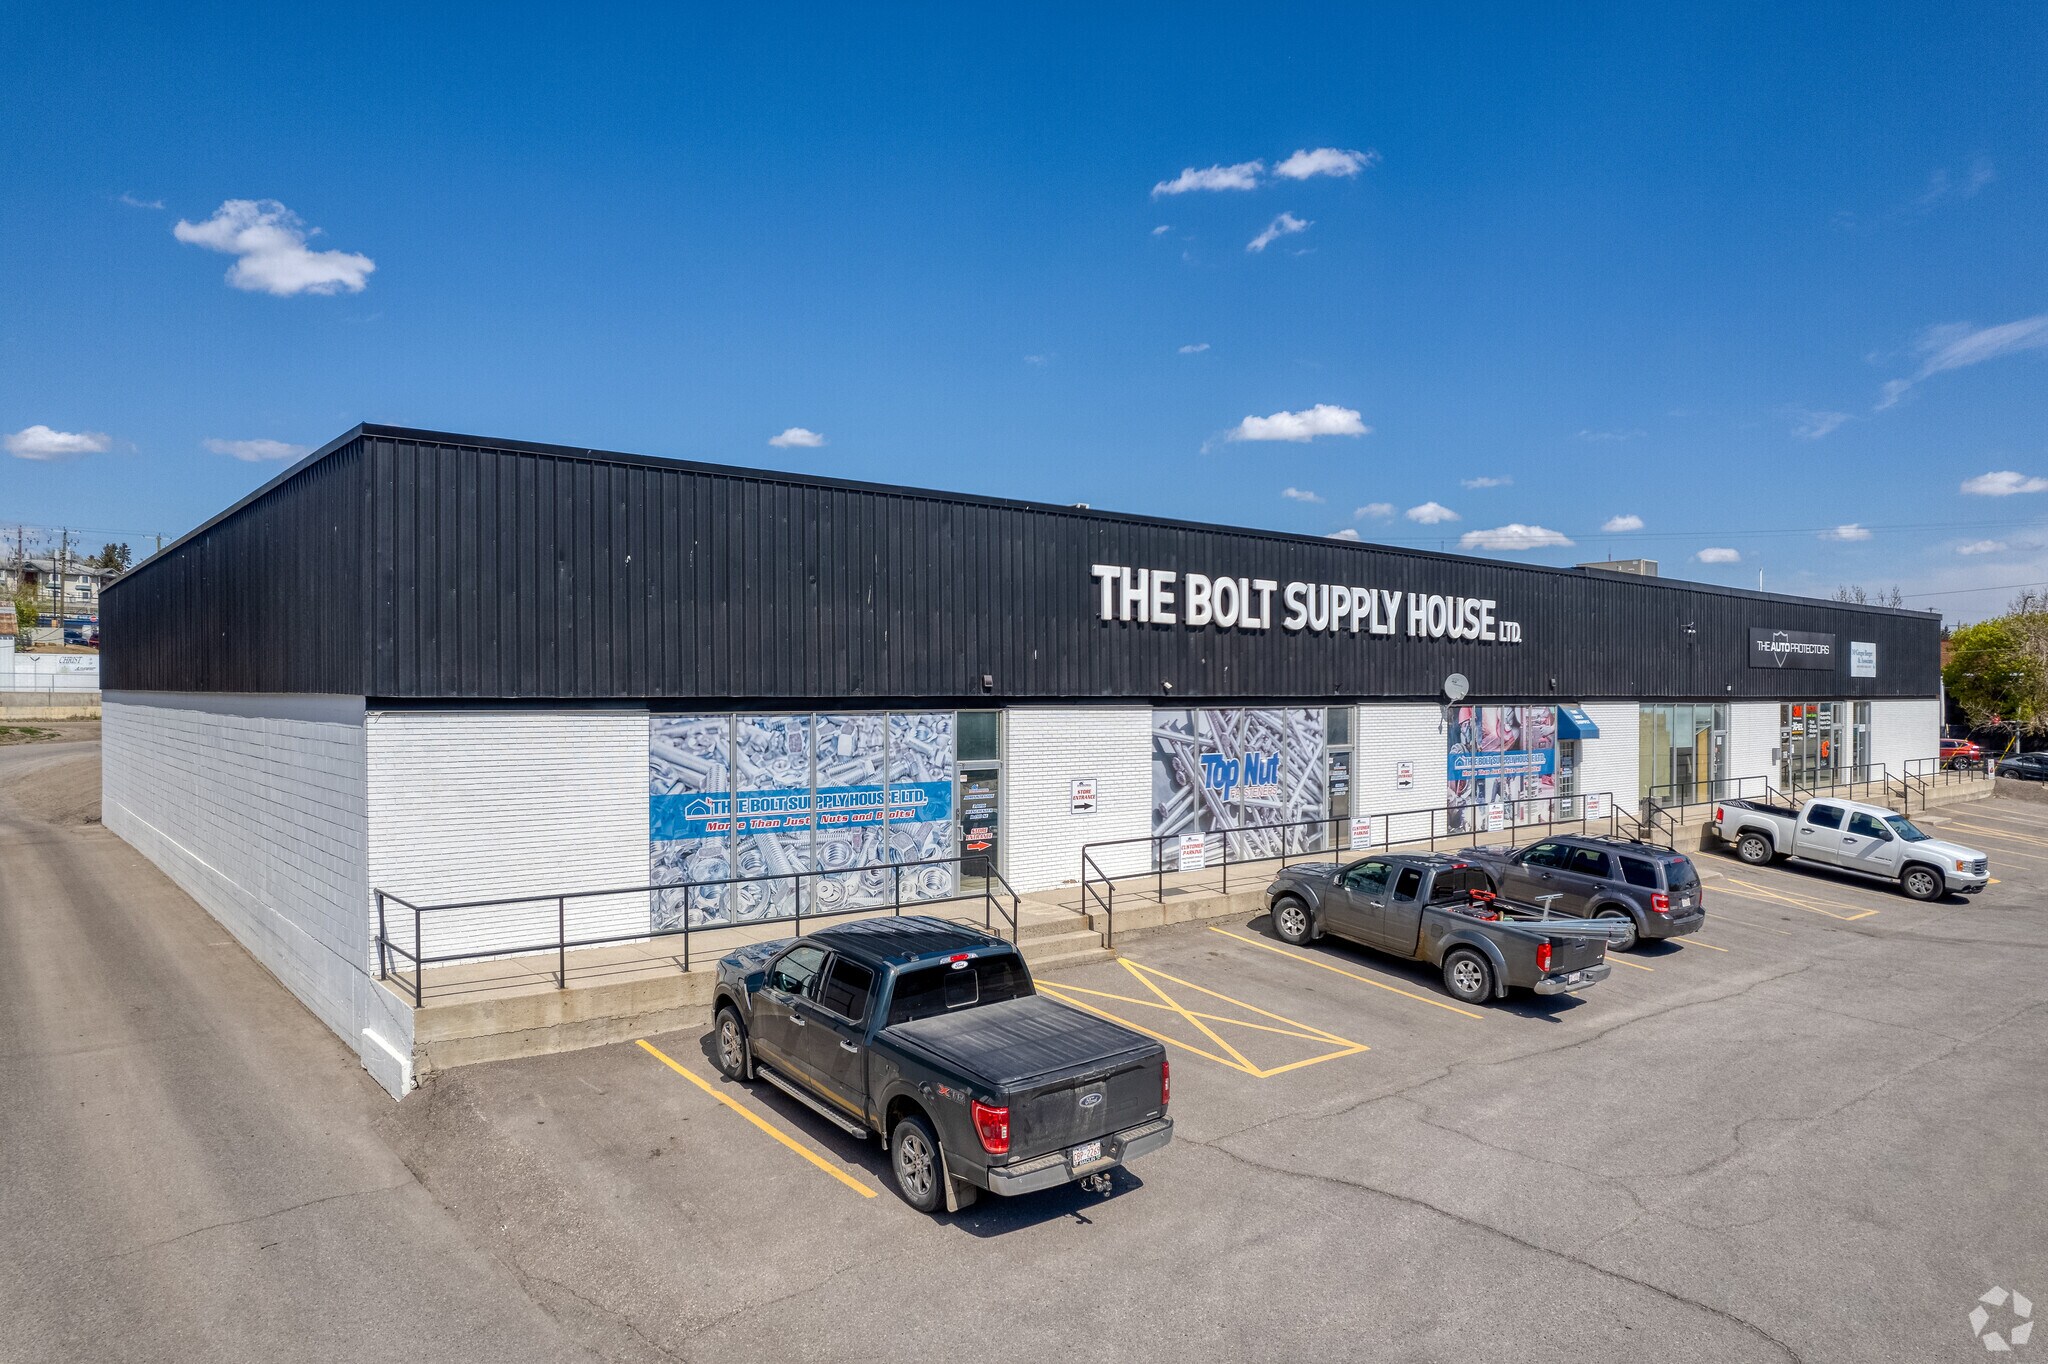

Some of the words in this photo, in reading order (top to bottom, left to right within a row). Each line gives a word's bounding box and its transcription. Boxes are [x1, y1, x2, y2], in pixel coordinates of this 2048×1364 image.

[1092, 564, 1176, 624] THE
[1185, 573, 1277, 629] BOLT
[1283, 582, 1402, 635] SUPPLY
[1408, 594, 1496, 641] HOUSE
[1499, 621, 1522, 642] LTD.
[1756, 640, 1771, 652] THE
[1771, 641, 1790, 653] AUTO
[1790, 642, 1830, 655] PROTECTORS
[1200, 753, 1241, 802] Top
[1243, 751, 1280, 786] Nut
[712, 798, 748, 815] THE
[750, 797, 785, 813] BOLT
[788, 794, 848, 810] SUPPLY
[849, 790, 899, 807] HOUSE
[901, 789, 928, 803] LTD.
[706, 821, 746, 832] More
[750, 819, 780, 829] Than
[783, 816, 811, 827] Just
[820, 814, 849, 824] Nuts
[852, 812, 873, 822] and
[876, 809, 915, 820] Bolts!
